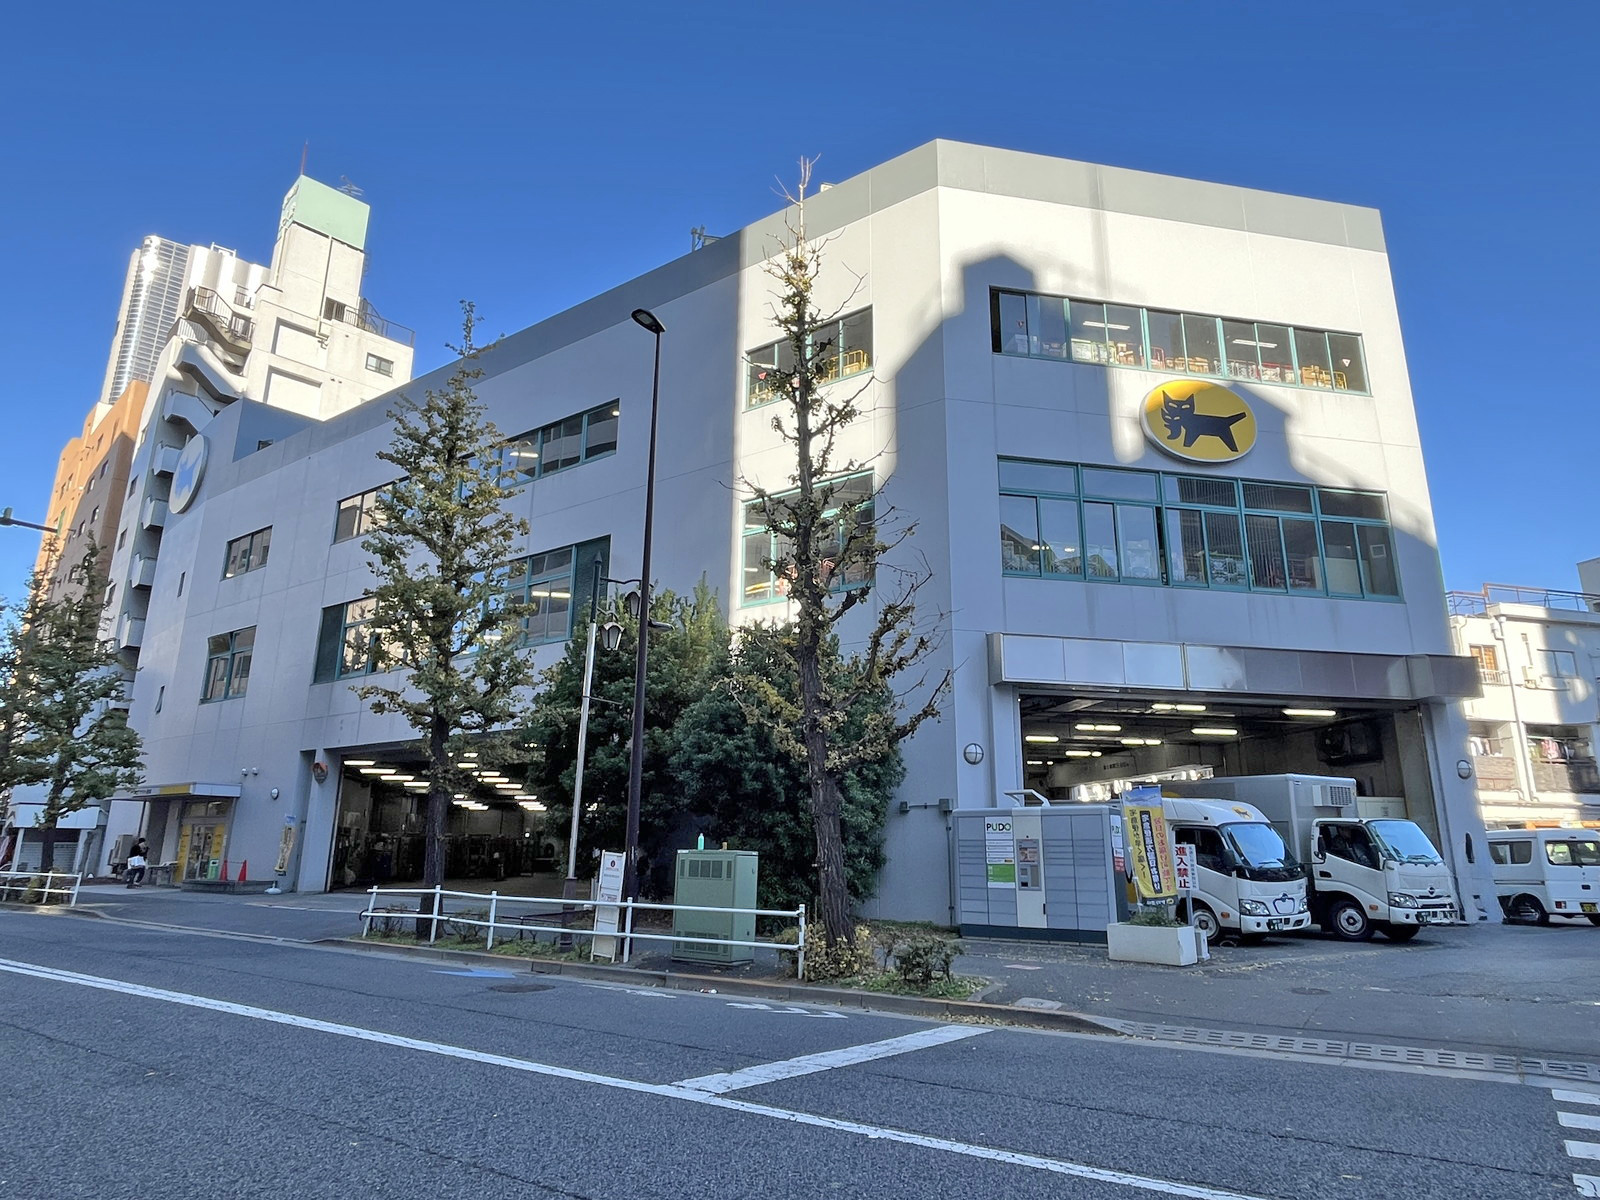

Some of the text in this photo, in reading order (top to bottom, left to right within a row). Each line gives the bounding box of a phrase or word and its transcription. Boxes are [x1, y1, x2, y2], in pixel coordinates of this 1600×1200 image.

[986, 823, 1011, 831] PUDO
[1175, 846, 1191, 888] 進入禁止
